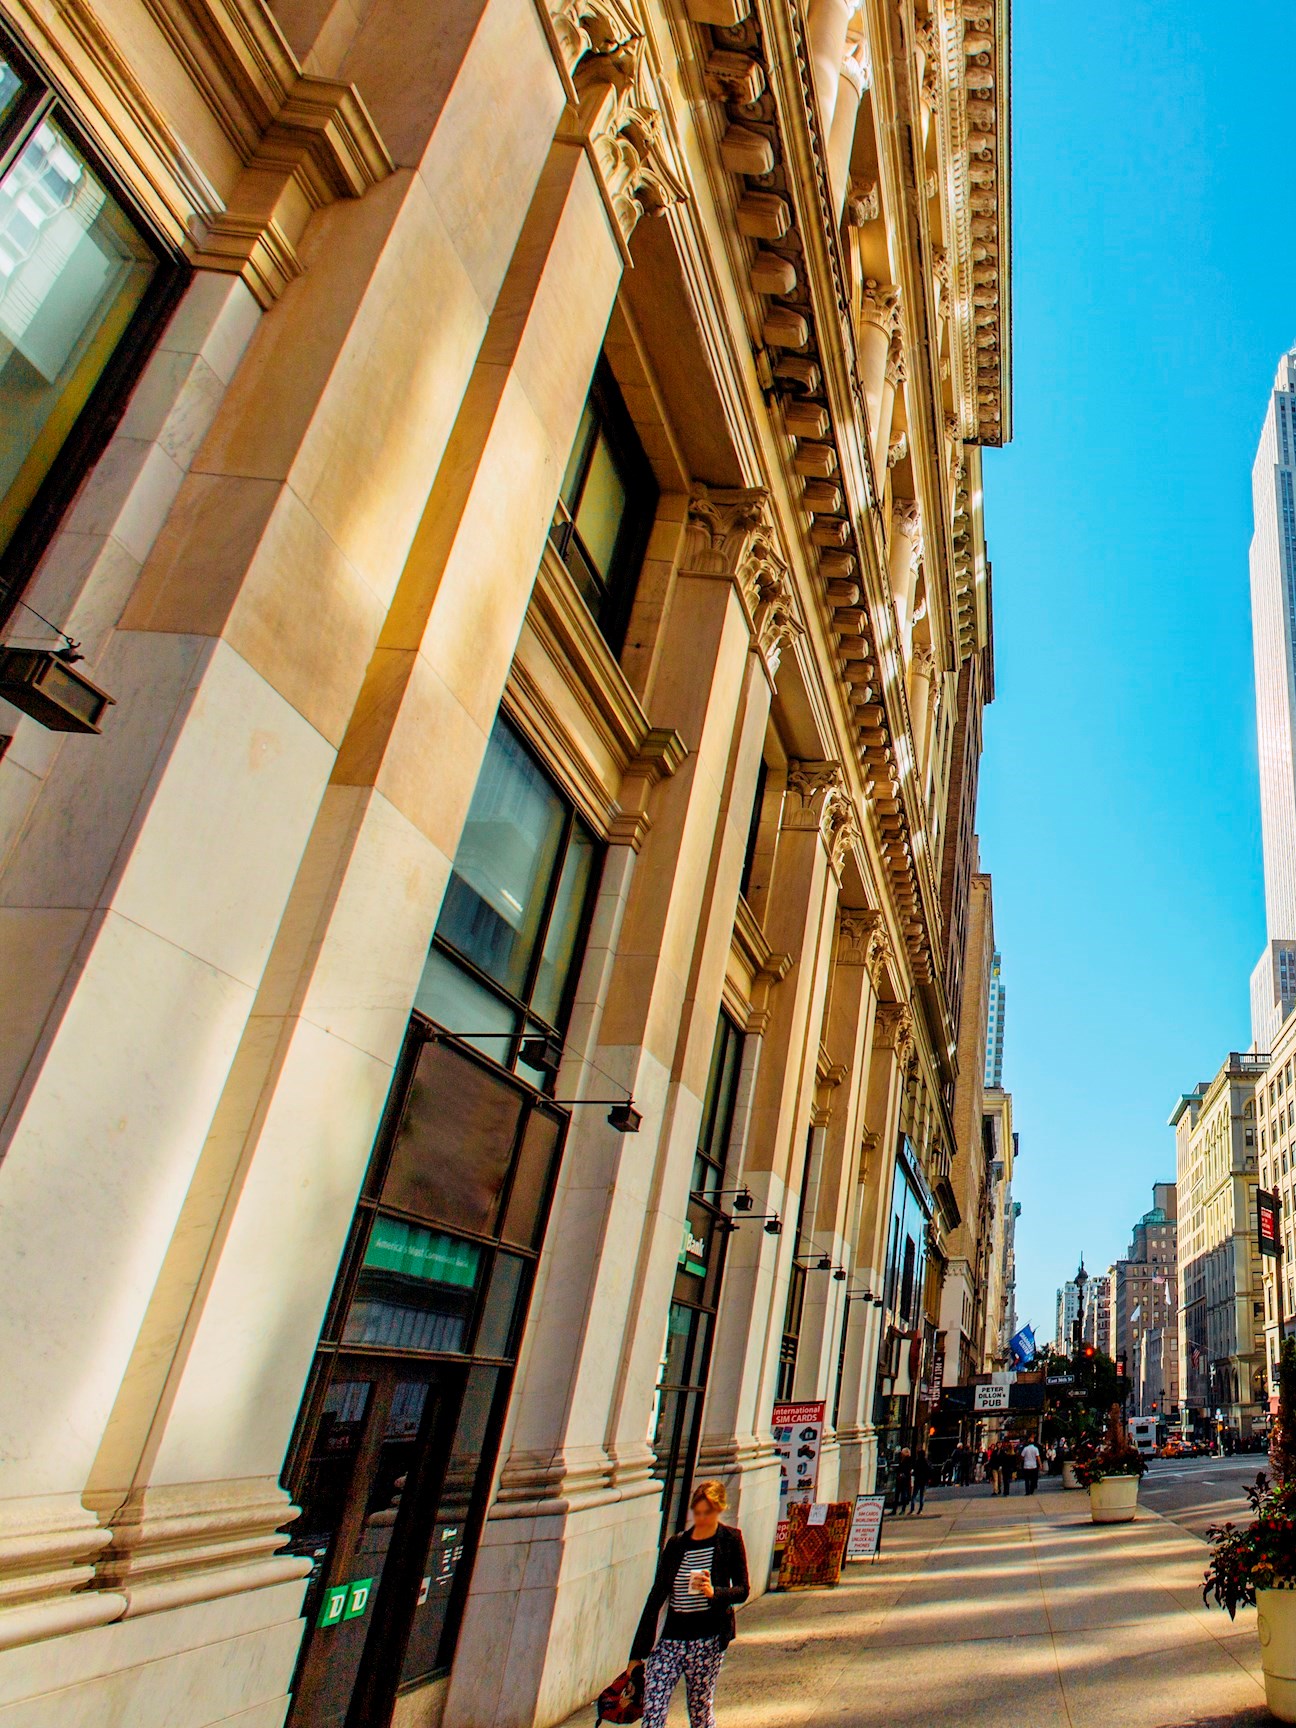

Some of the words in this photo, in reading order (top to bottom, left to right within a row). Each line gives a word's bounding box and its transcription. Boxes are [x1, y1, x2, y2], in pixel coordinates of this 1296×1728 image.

[686, 1232, 704, 1258] Bank
[773, 1406, 820, 1415] International
[982, 1399, 1002, 1407] PUB
[776, 1415, 790, 1423] SIM
[791, 1414, 817, 1423] CARDS
[328, 1594, 345, 1619] TD
[352, 1587, 369, 1612] TD
